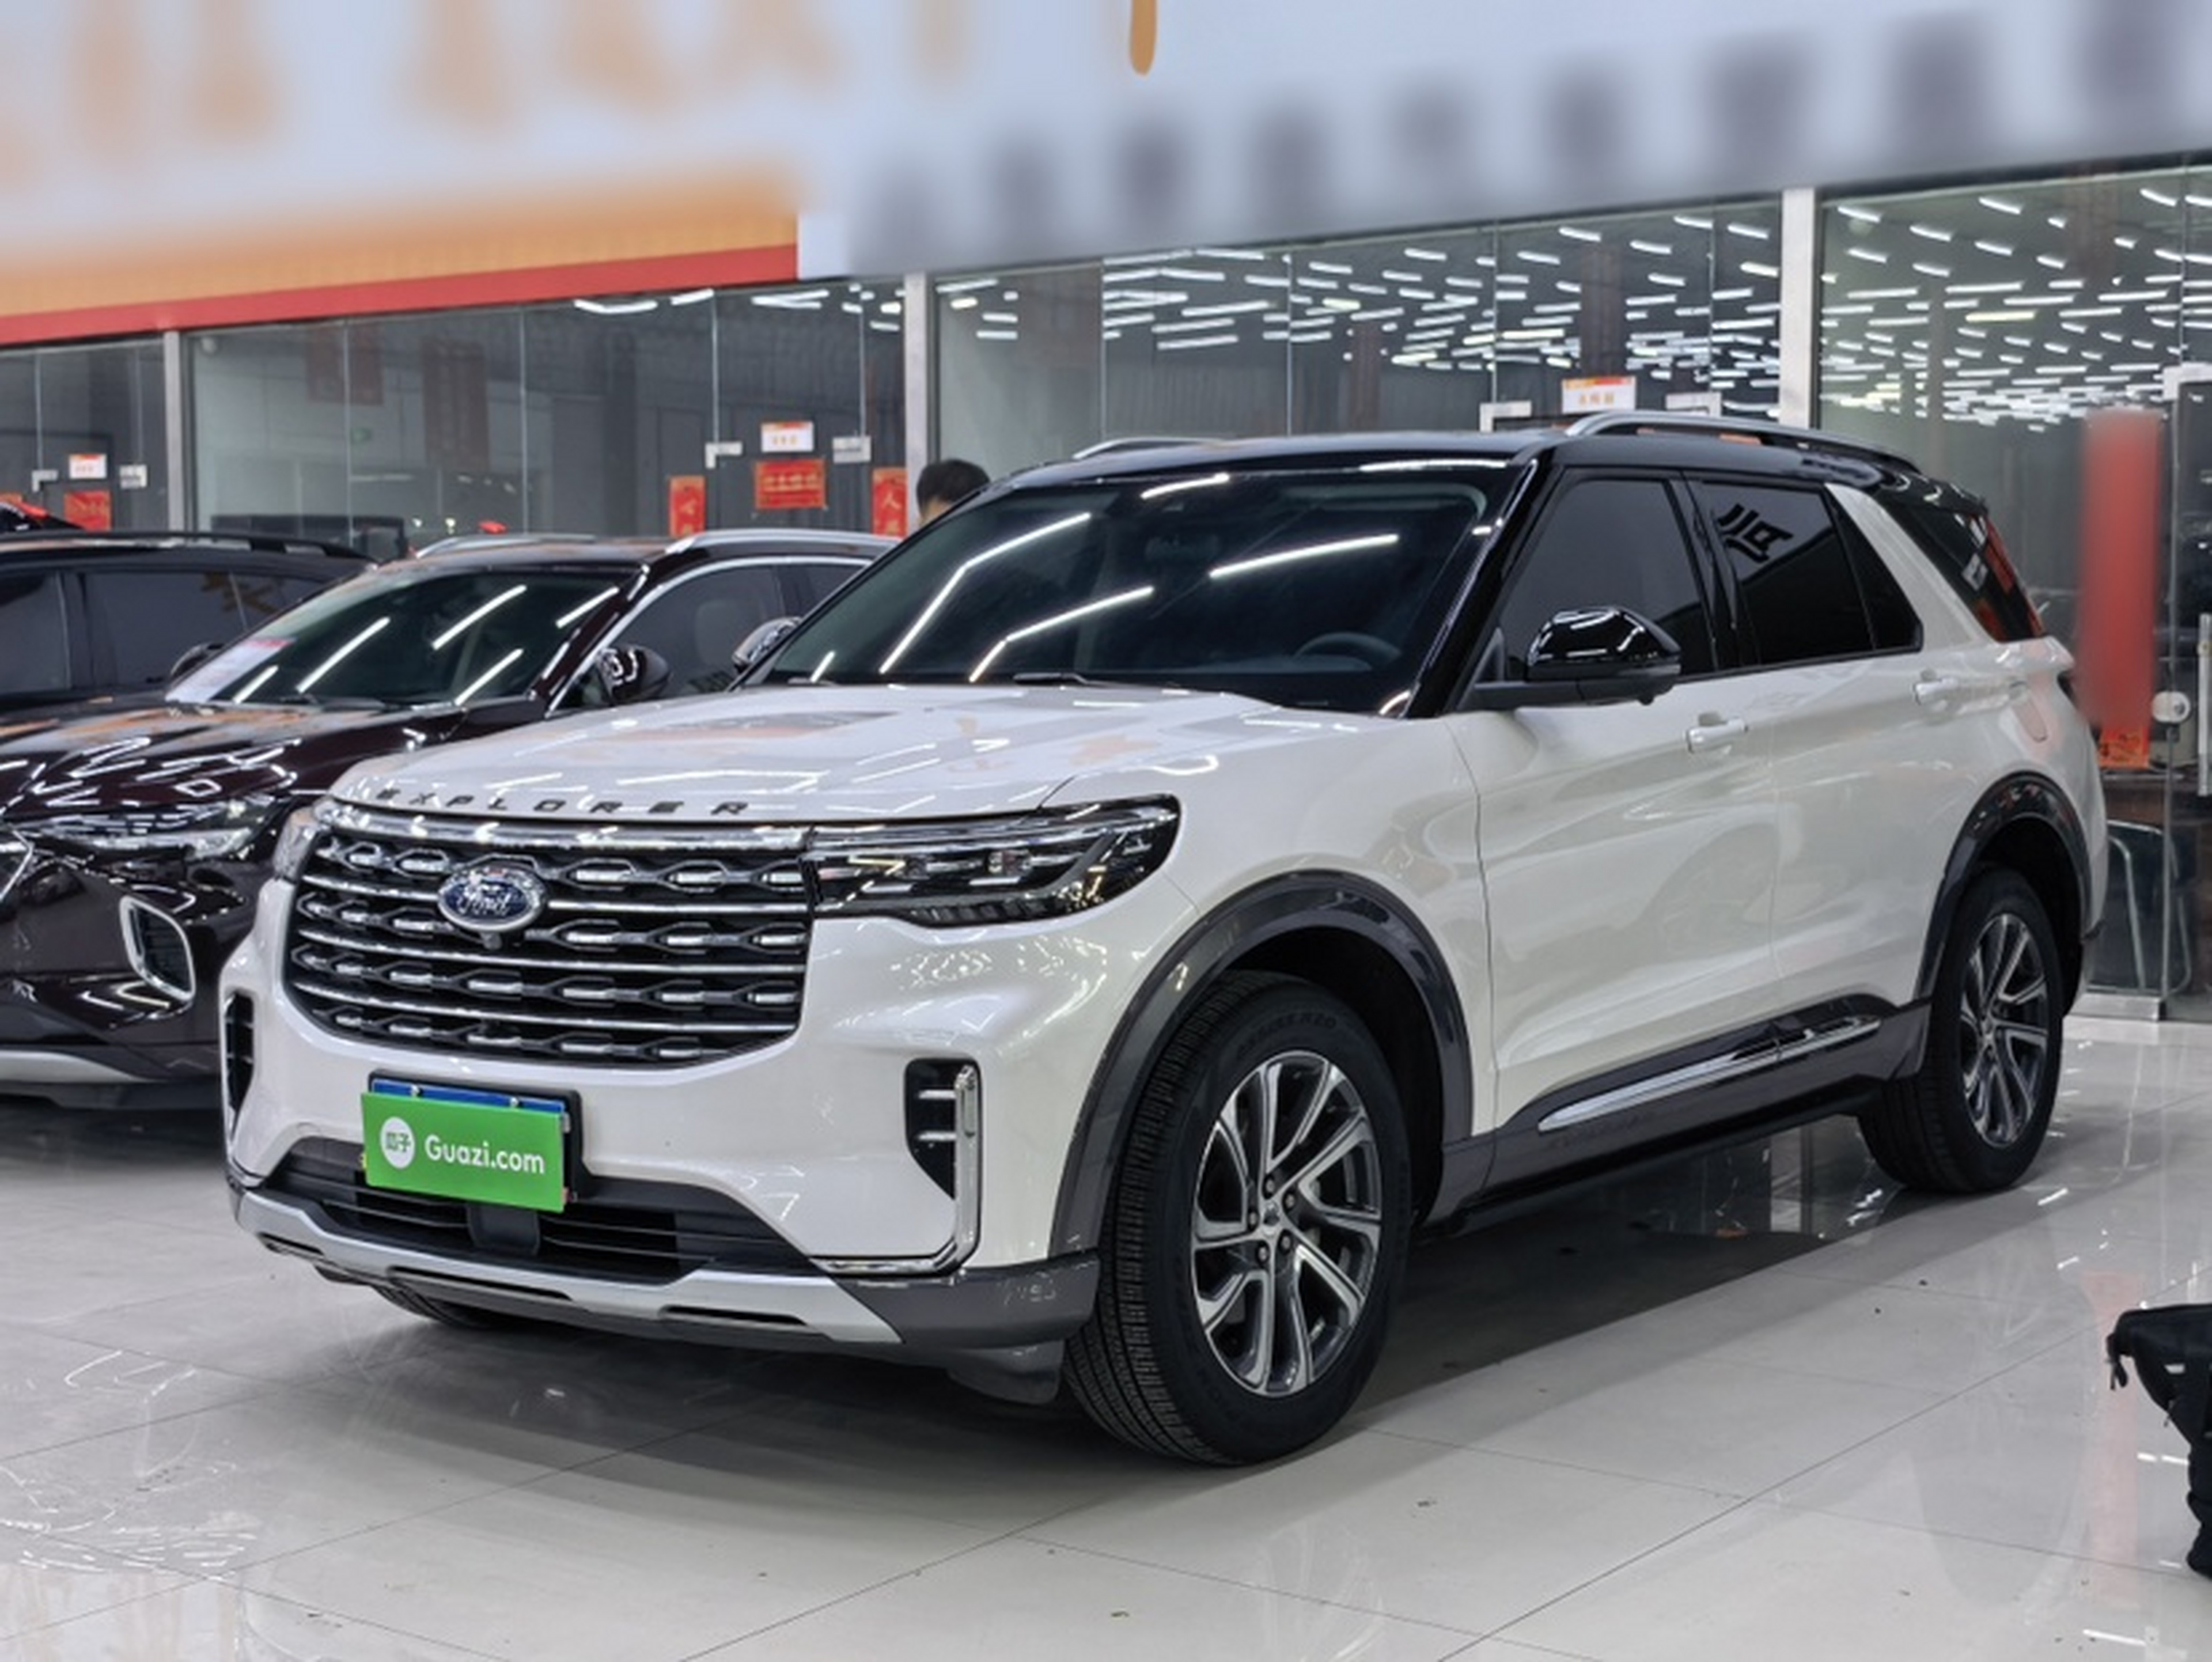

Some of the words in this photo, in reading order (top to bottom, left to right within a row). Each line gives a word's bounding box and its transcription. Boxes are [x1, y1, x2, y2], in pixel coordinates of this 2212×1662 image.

[376, 788, 749, 815] EXPLORER
[456, 885, 512, 916] Ford
[424, 1133, 545, 1175] Guazi.com
